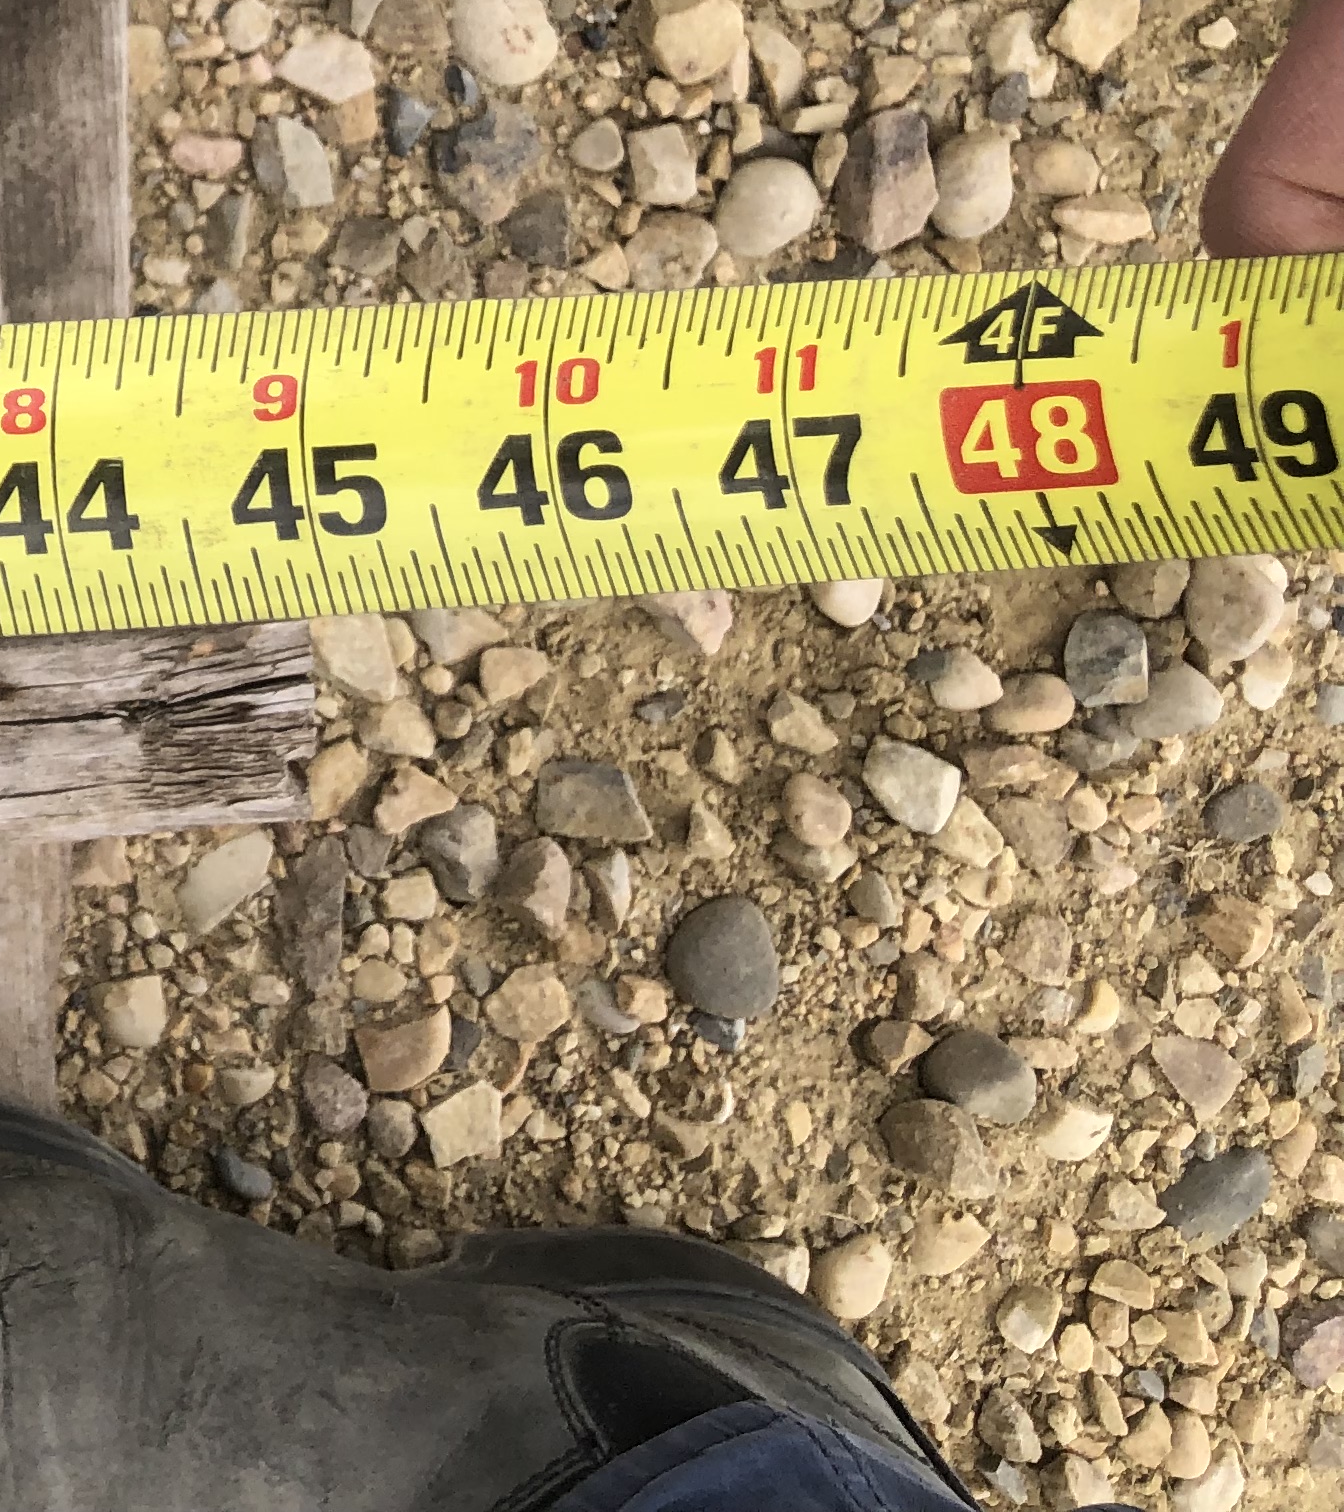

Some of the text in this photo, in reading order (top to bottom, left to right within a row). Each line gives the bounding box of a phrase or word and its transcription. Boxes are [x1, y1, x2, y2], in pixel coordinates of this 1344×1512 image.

[977, 306, 1064, 354] 4F
[1219, 320, 1241, 368] 1
[0, 388, 46, 435] 8
[253, 374, 298, 422] 9
[514, 357, 601, 407] 10
[753, 344, 817, 394] 11
[231, 443, 387, 541] 45
[477, 429, 633, 527] 46
[718, 413, 863, 510] 47
[959, 394, 1099, 479] 48
[1188, 389, 1339, 483] 49
